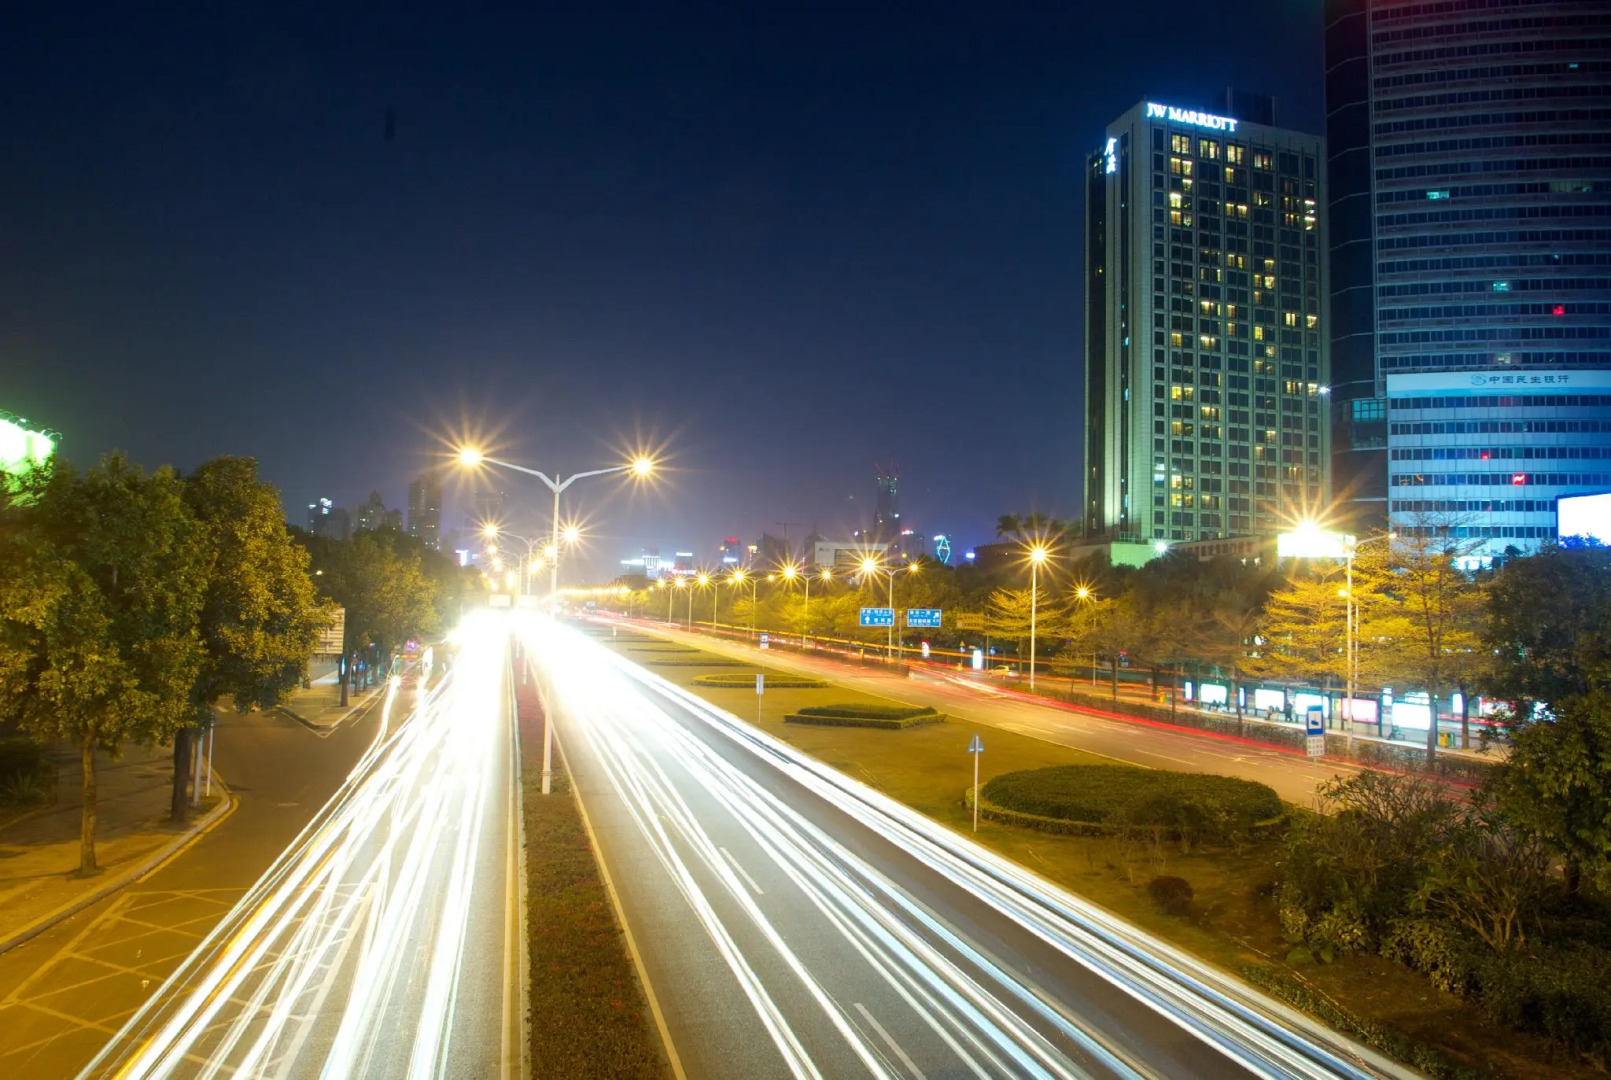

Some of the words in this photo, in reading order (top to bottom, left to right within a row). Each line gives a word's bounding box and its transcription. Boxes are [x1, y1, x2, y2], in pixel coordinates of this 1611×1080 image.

[1147, 102, 1167, 118] JW
[1168, 106, 1238, 132] MARRIOTT
[1489, 374, 1569, 384] 中国民生银行
